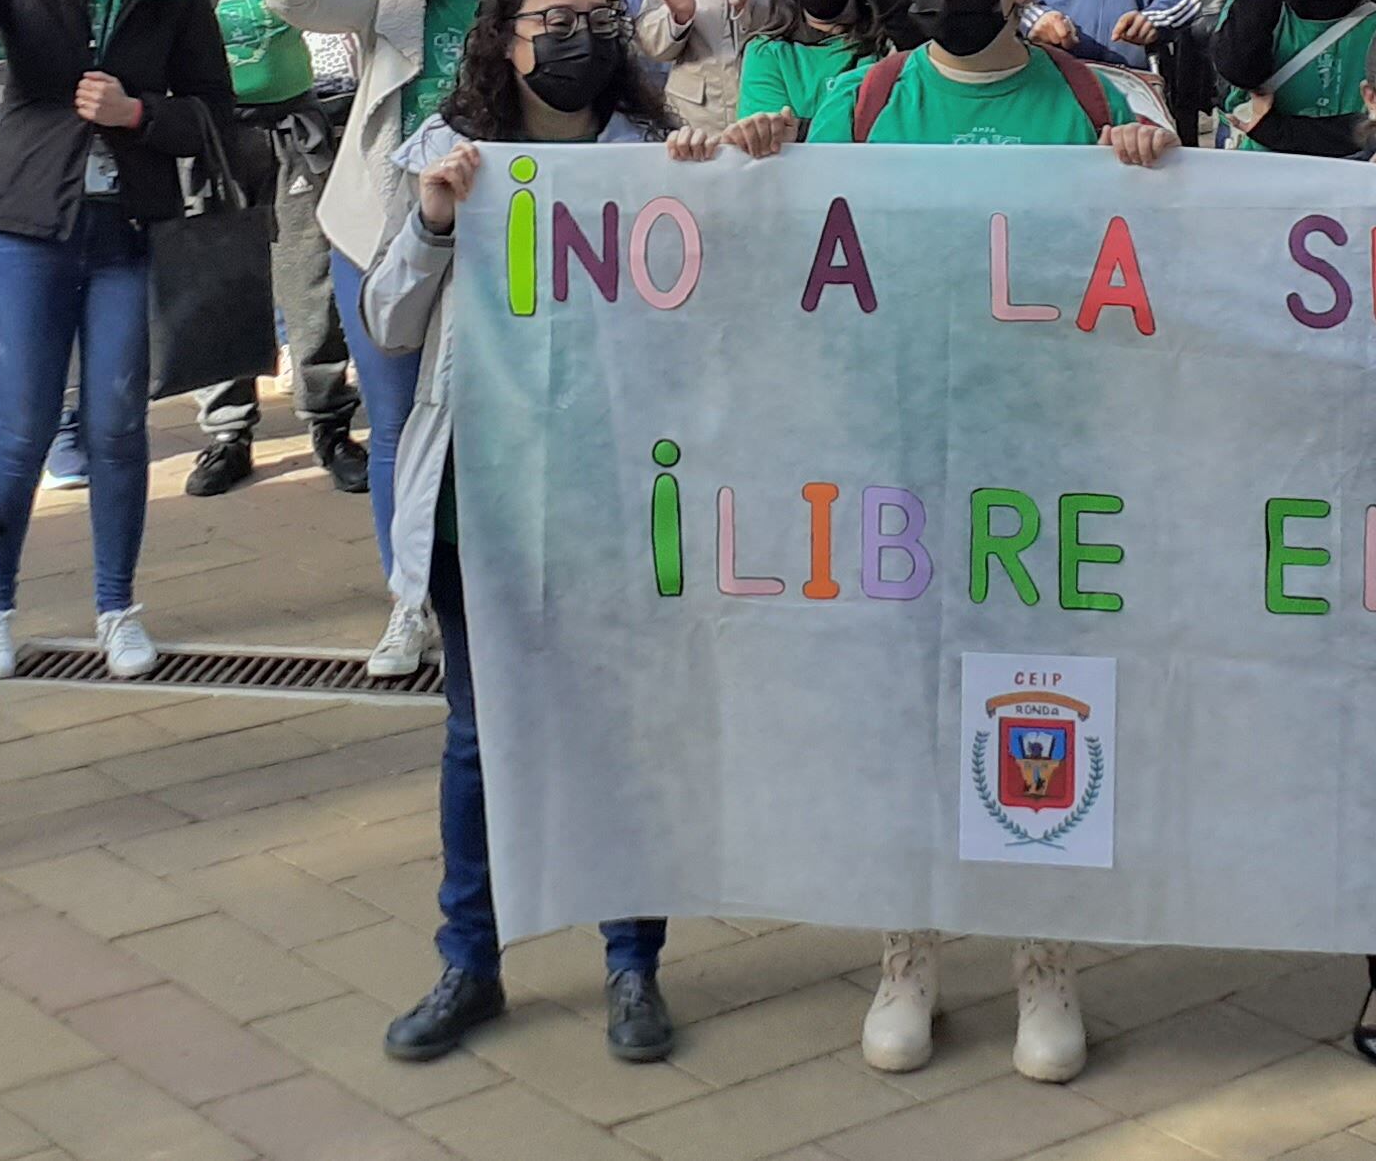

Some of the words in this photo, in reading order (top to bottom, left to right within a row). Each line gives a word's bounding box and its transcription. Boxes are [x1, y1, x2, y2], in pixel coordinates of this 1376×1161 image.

[507, 155, 703, 317] ¡NO
[801, 196, 878, 314] A
[989, 212, 1157, 336] LA
[651, 439, 1124, 612] ¡LIBRE
[1014, 671, 1062, 686] CEIP
[1015, 704, 1060, 716] RONDA
